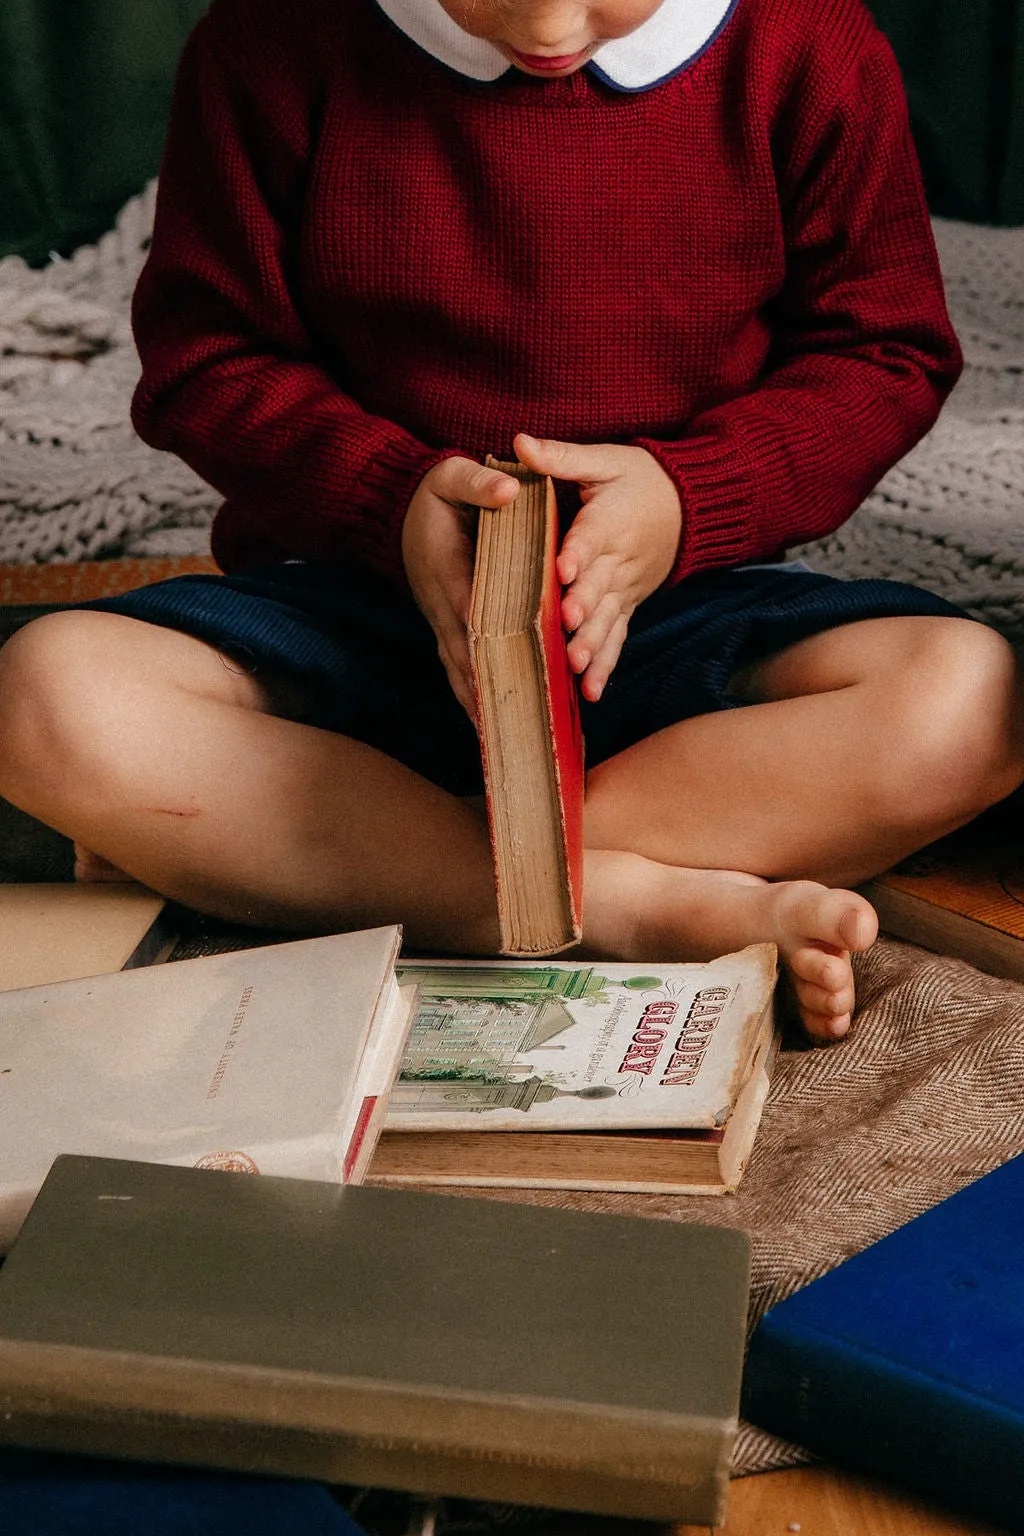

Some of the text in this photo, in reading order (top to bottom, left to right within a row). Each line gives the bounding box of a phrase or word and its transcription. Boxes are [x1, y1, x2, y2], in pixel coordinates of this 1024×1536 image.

[206, 986, 254, 1100] UNIVERSITY OF WALES PRESS
[617, 1000, 680, 1076] GLORY
[659, 985, 732, 1086] GARDEN
